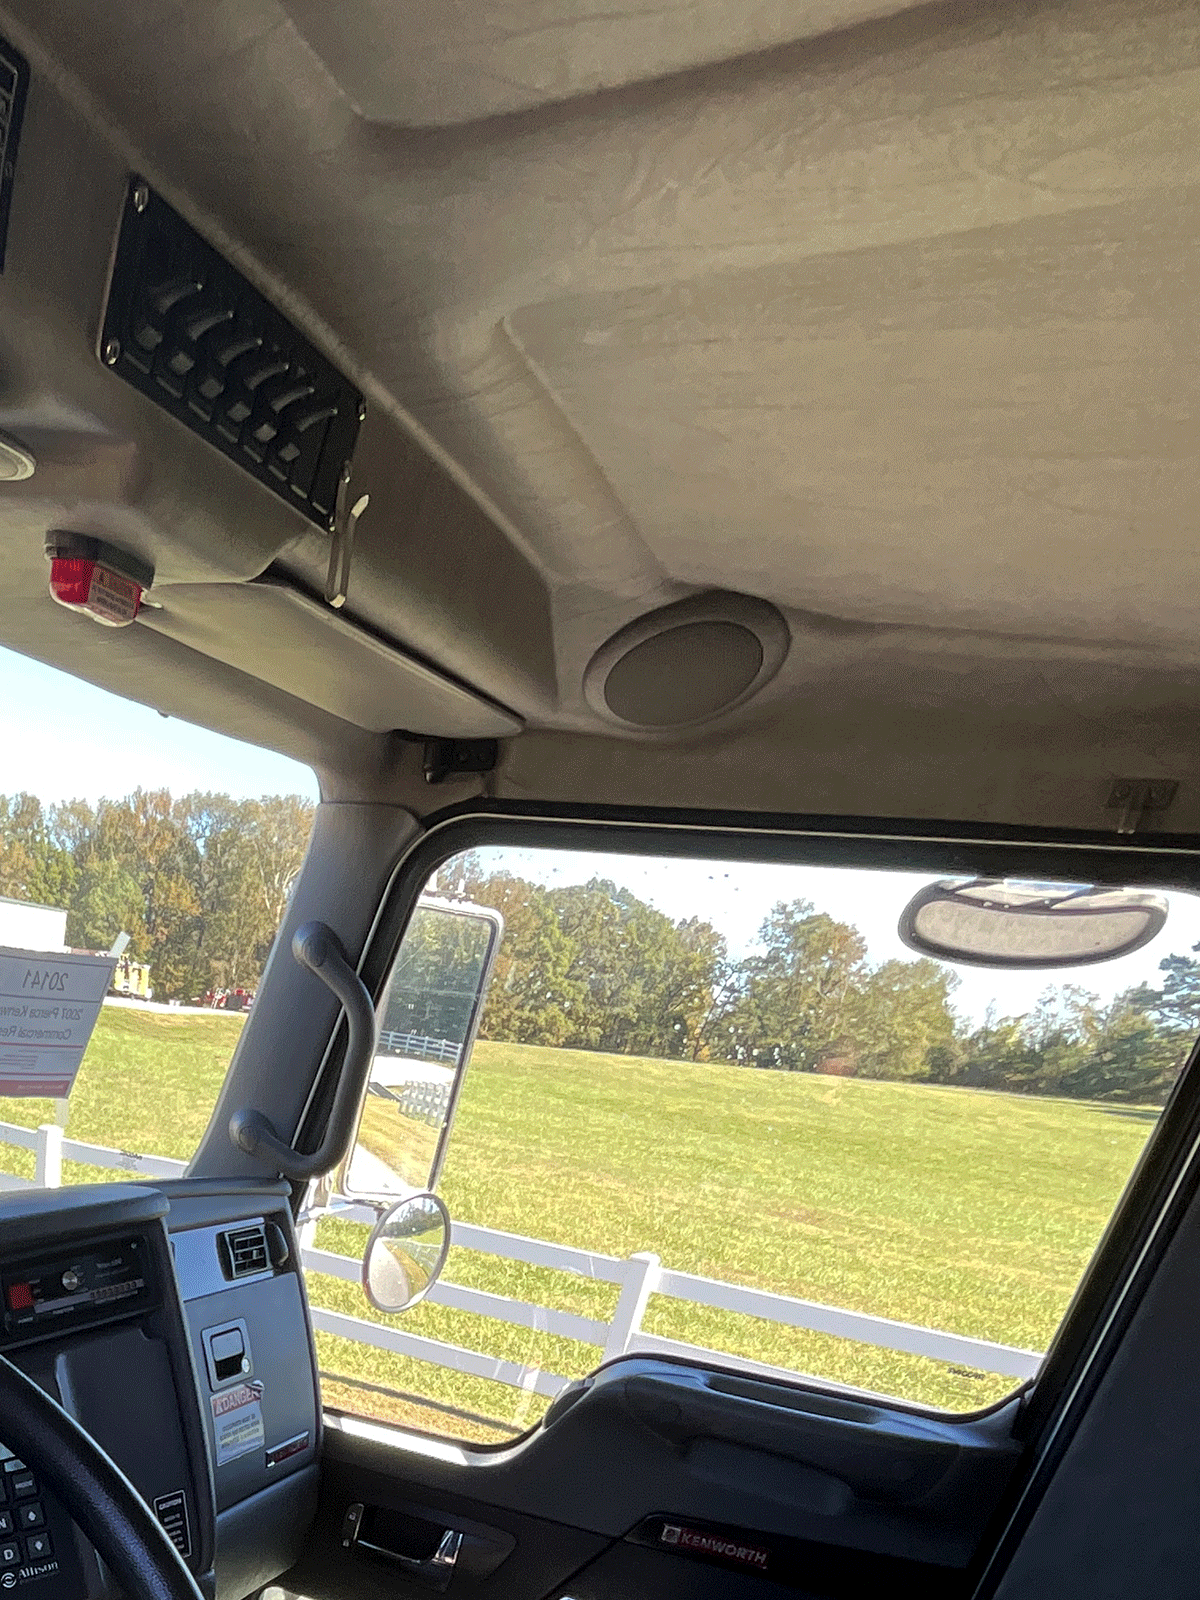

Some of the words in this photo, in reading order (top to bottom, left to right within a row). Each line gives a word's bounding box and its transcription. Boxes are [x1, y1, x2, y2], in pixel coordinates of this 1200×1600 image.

[3, 1549, 14, 1561] D
[681, 1532, 768, 1564] KENWORTH
[18, 1561, 59, 1579] Allison
